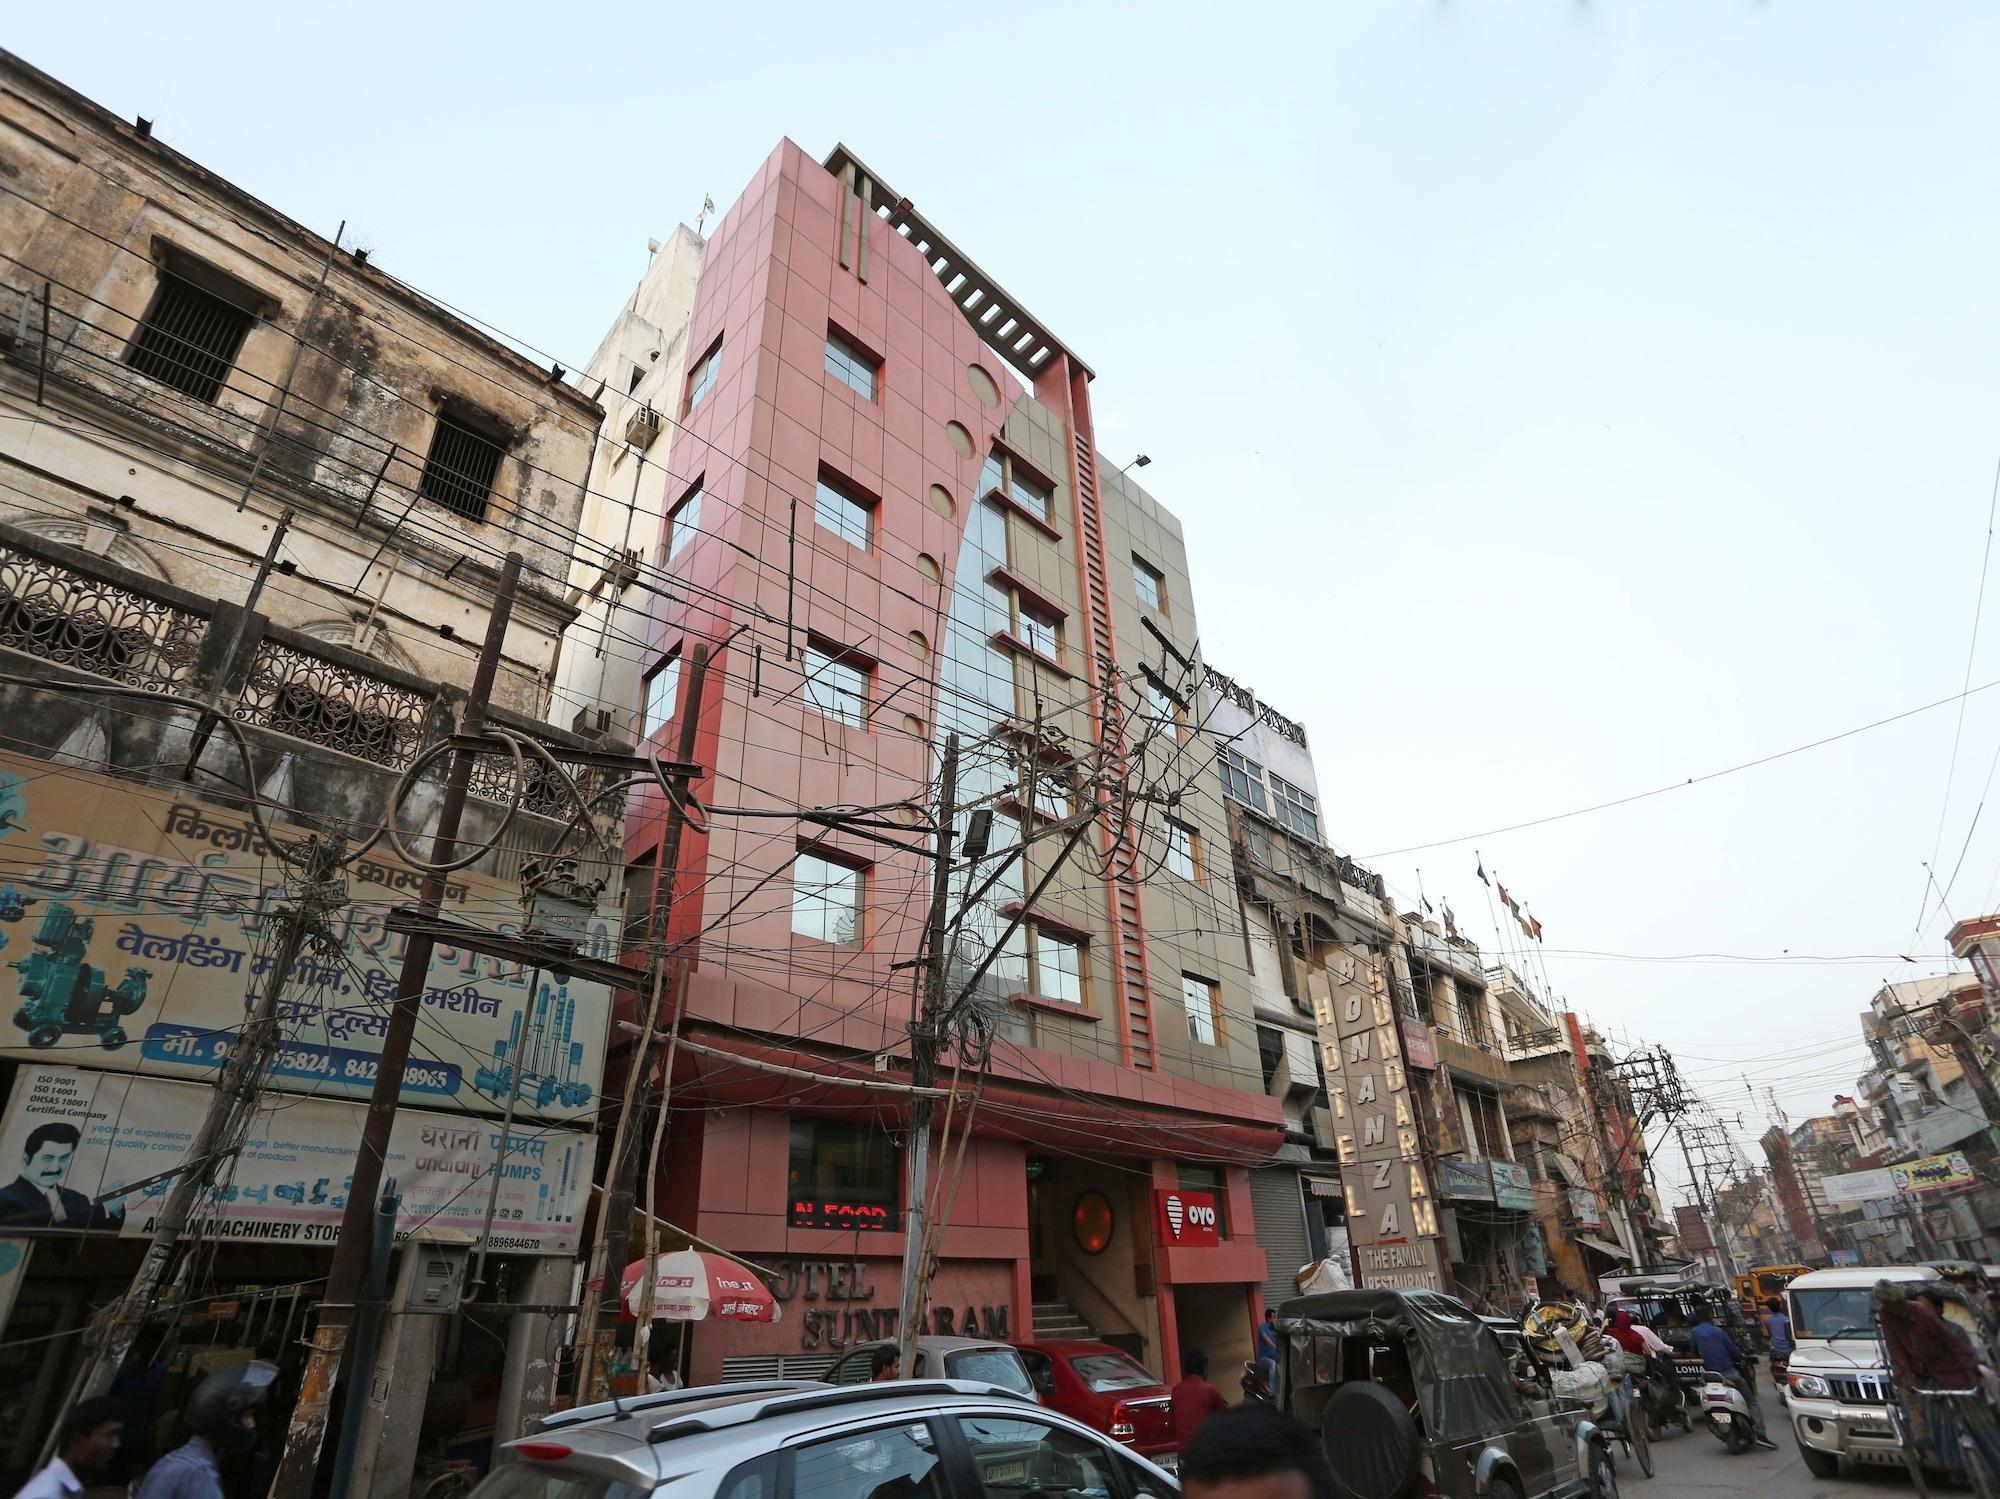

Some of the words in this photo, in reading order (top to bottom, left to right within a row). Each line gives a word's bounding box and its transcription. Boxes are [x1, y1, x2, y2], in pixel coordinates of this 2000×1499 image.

[116, 922, 246, 973] वेलडिंग
[424, 985, 502, 1018] मशीन
[37, 1075, 53, 1084] ISO
[54, 1077, 76, 1086] 9001
[345, 1057, 449, 1088] 8428965
[30, 1095, 60, 1105] OHSAS
[62, 1098, 88, 1107] 18001
[33, 1085, 49, 1093] ISO
[51, 1087, 78, 1096] 14001
[1338, 956, 1400, 1236] BONANZA
[1365, 963, 1440, 1238] SUNDARAM
[26, 1105, 66, 1116] Certified
[67, 1109, 108, 1121] Company
[1314, 995, 1367, 1218] HOTEL
[122, 1126, 134, 1135] of
[135, 1129, 193, 1141] experience
[114, 1139, 150, 1151] quality
[151, 1141, 186, 1152] control
[487, 1161, 542, 1181] PUMPS
[1188, 1205, 1215, 1225] OYO
[204, 1220, 302, 1240] MACHINERY
[304, 1223, 342, 1241] STOR
[488, 1235, 540, 1250] 8896844670
[1367, 1248, 1389, 1271] THE
[1391, 1244, 1427, 1268] FAMILY
[768, 1259, 875, 1303] OTEL
[803, 1304, 1011, 1349] SUNRAM
[1675, 1365, 1706, 1374] LOHIA
